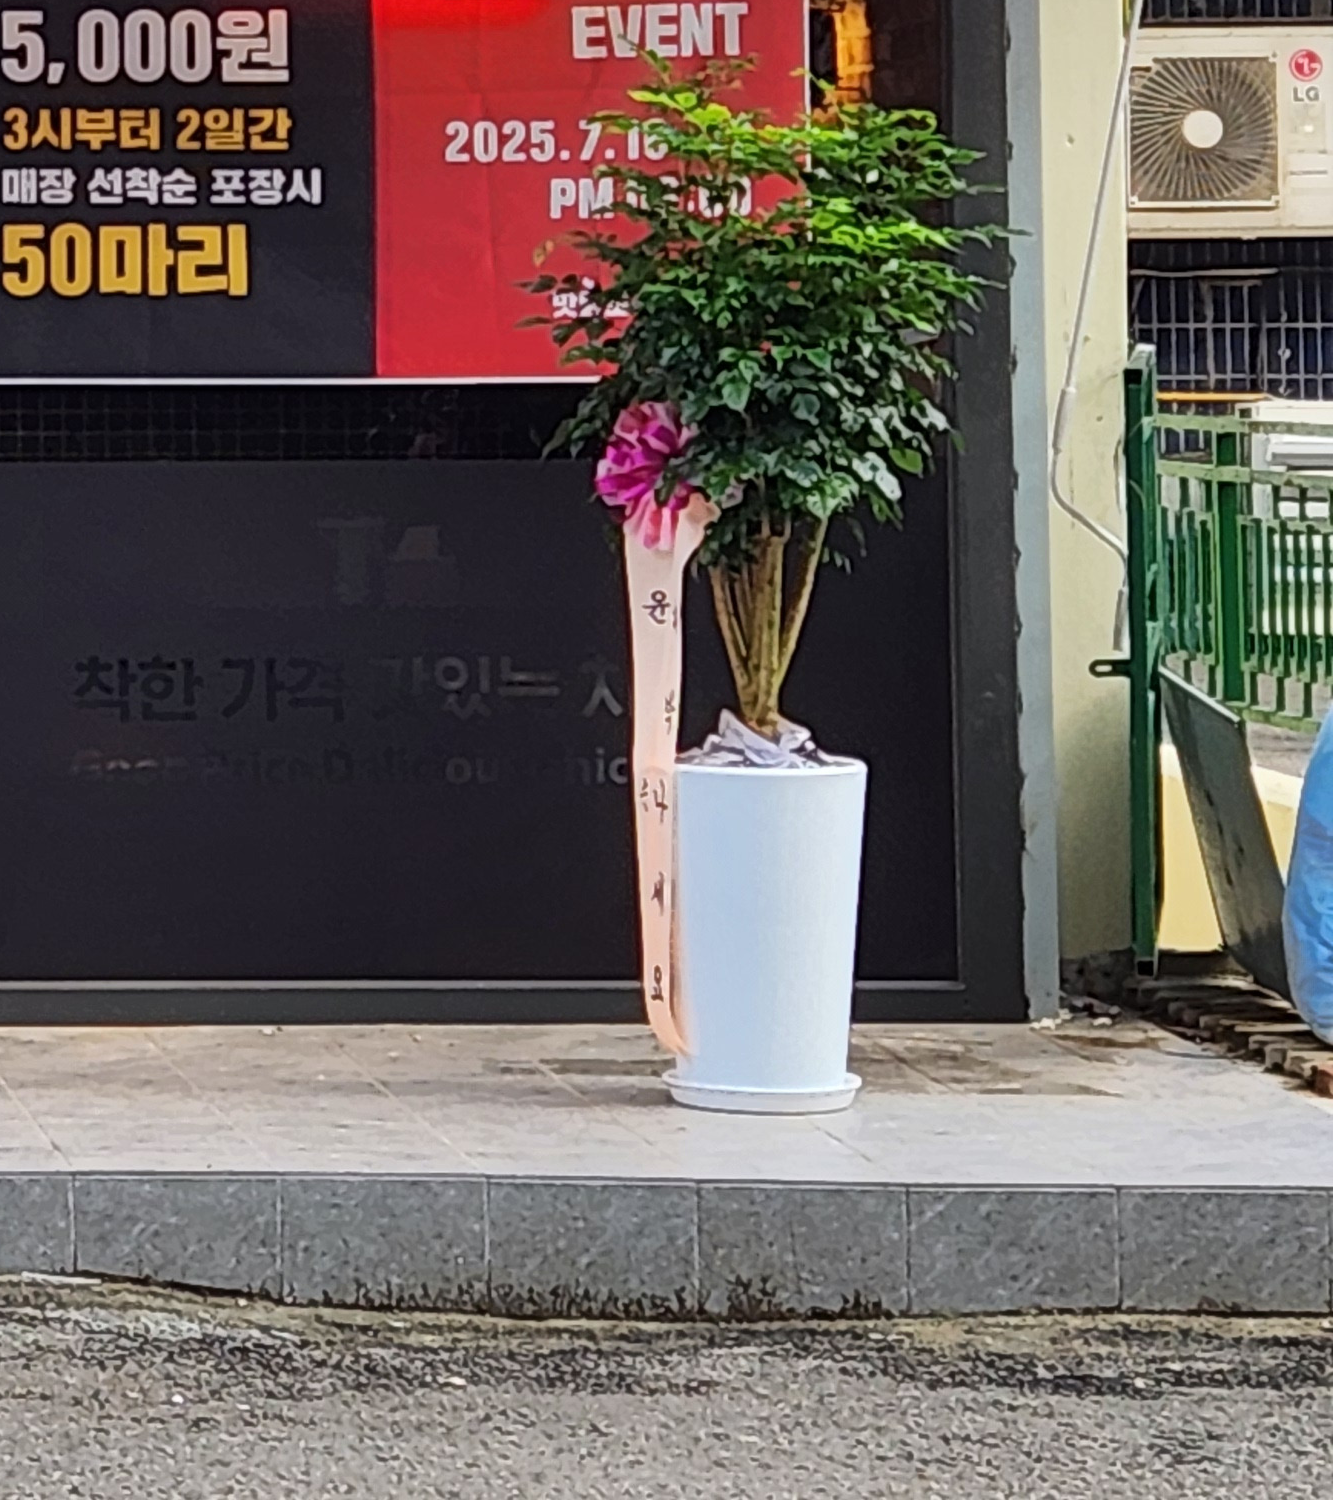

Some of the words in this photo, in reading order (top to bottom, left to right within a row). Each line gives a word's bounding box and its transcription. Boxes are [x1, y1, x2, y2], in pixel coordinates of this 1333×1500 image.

[0, 8, 291, 85] 5,000원
[571, 1, 749, 60] EVENT
[1292, 86, 1320, 103] LG
[2, 107, 162, 151] 3시부터
[175, 107, 293, 151] 2일간
[1, 167, 77, 205] 매장
[86, 167, 199, 205] 선착순
[209, 167, 324, 205] 포장시
[549, 177, 615, 220] PM
[1, 222, 249, 298] 50마리
